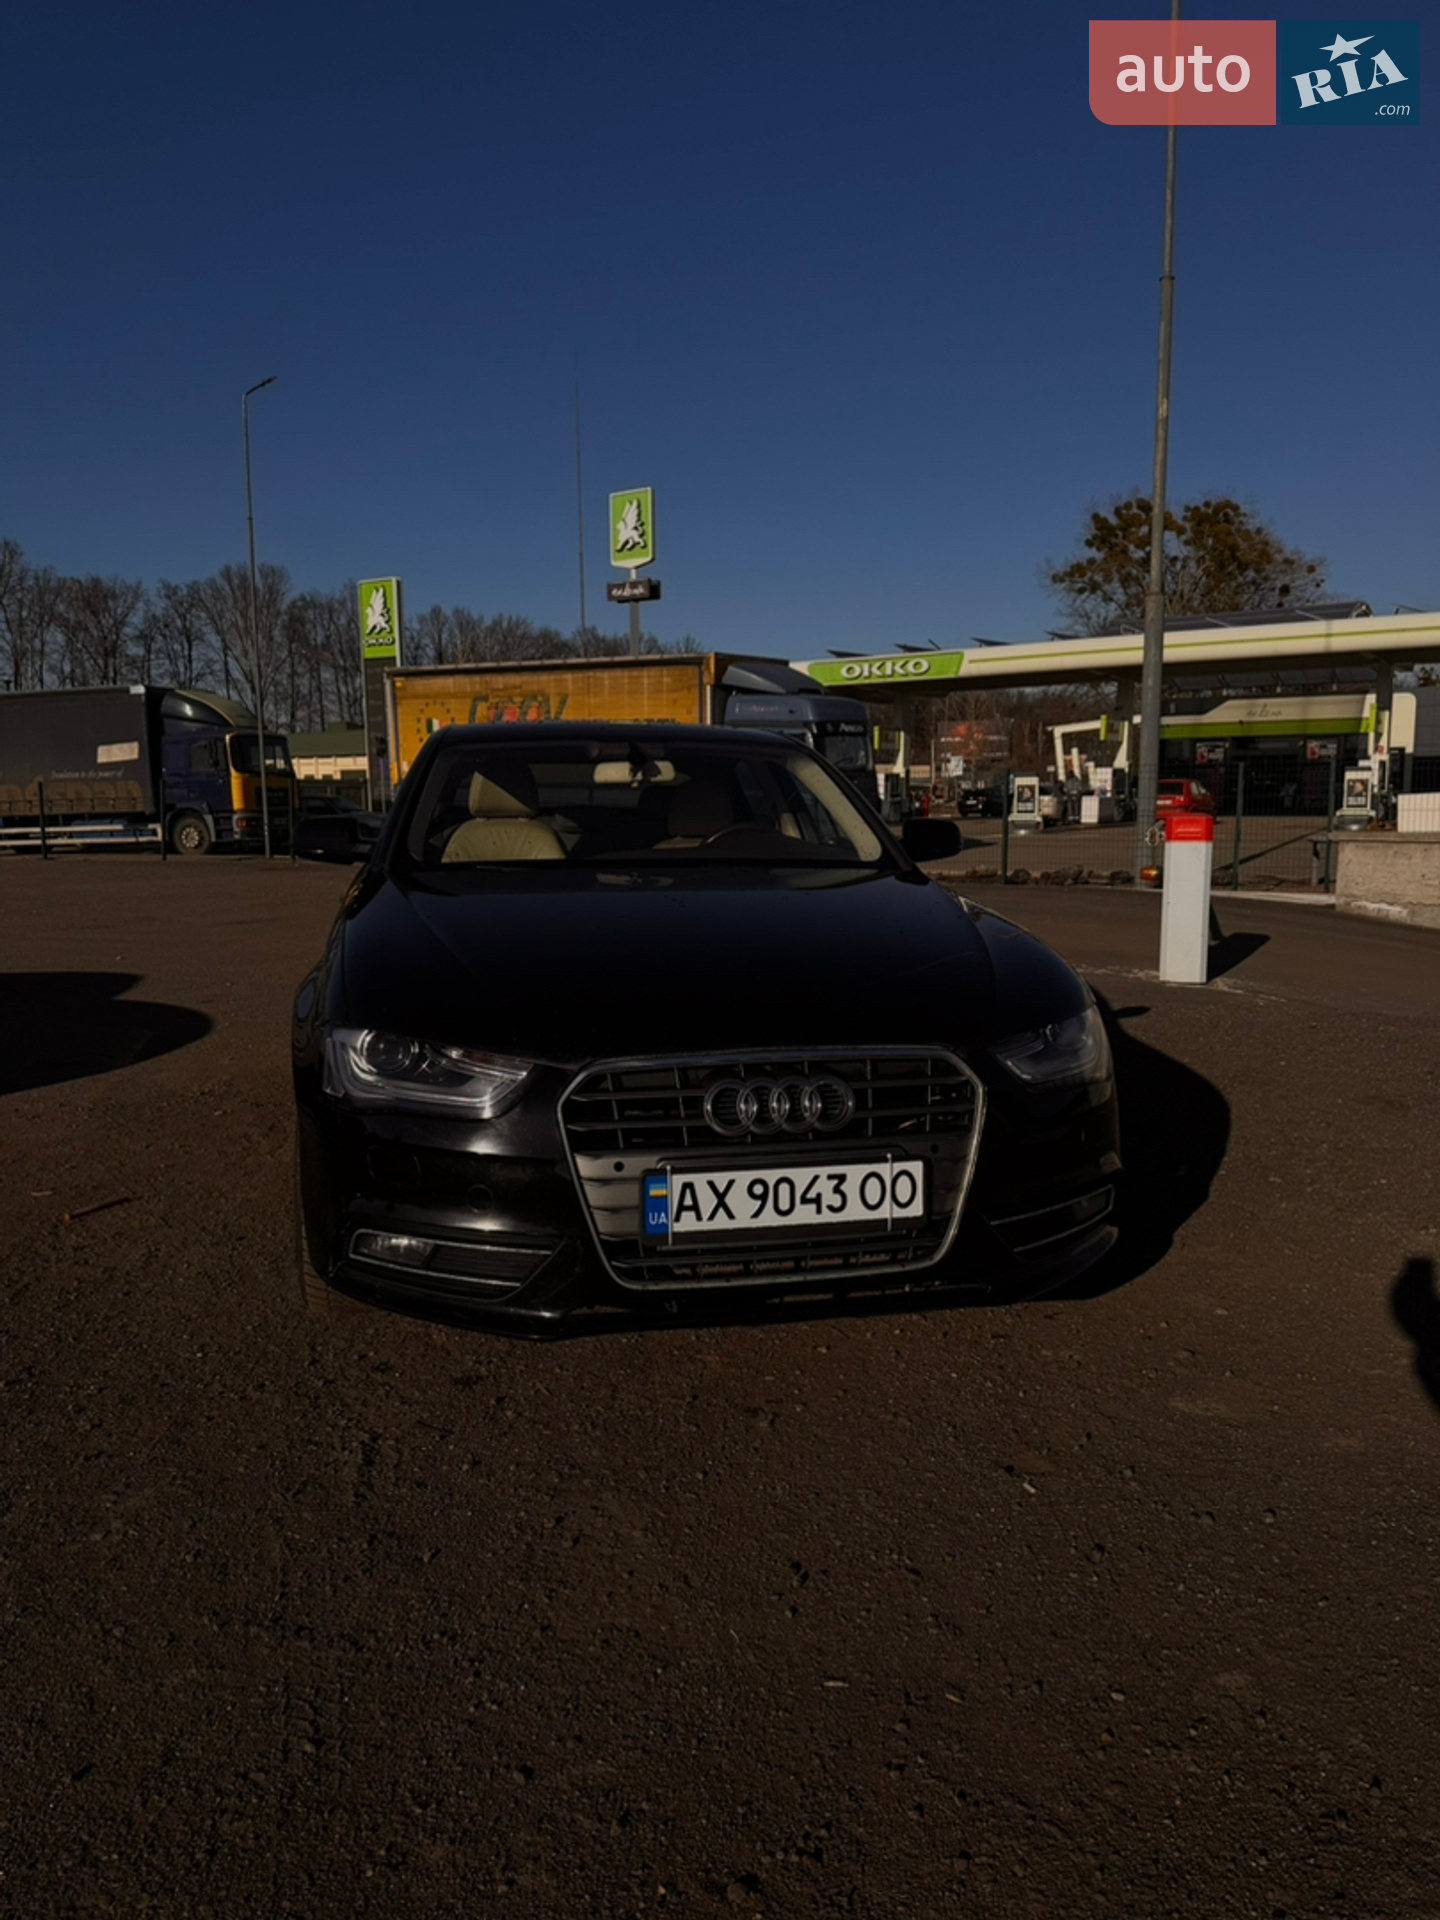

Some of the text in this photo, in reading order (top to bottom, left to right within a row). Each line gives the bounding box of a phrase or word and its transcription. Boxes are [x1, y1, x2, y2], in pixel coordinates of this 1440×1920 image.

[840, 658, 930, 680] OKKO
[674, 1169, 917, 1222] AX 9043 OO
[648, 1212, 668, 1226] UA
